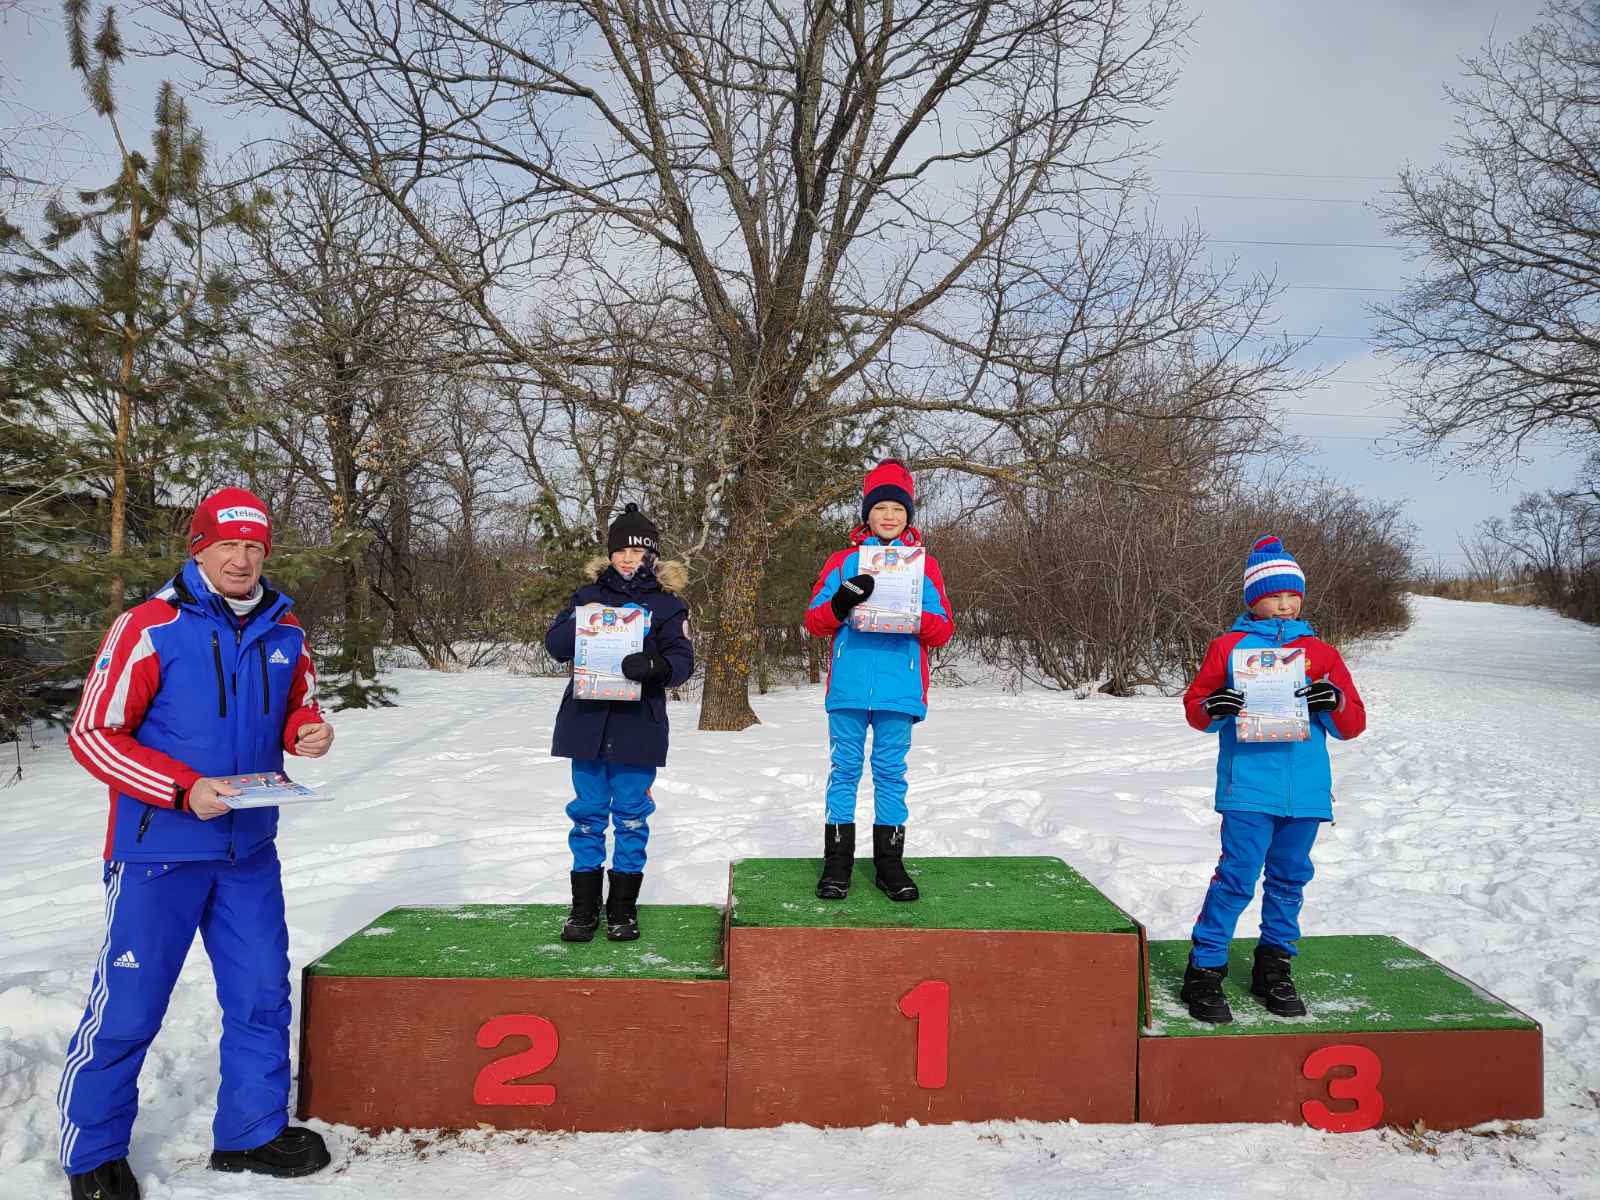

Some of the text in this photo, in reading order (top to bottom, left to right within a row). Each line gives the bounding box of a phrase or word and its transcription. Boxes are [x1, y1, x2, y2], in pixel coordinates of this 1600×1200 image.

[473, 1013, 559, 1106] 2
[899, 980, 951, 1089] 1
[1301, 1044, 1384, 1133] 3
